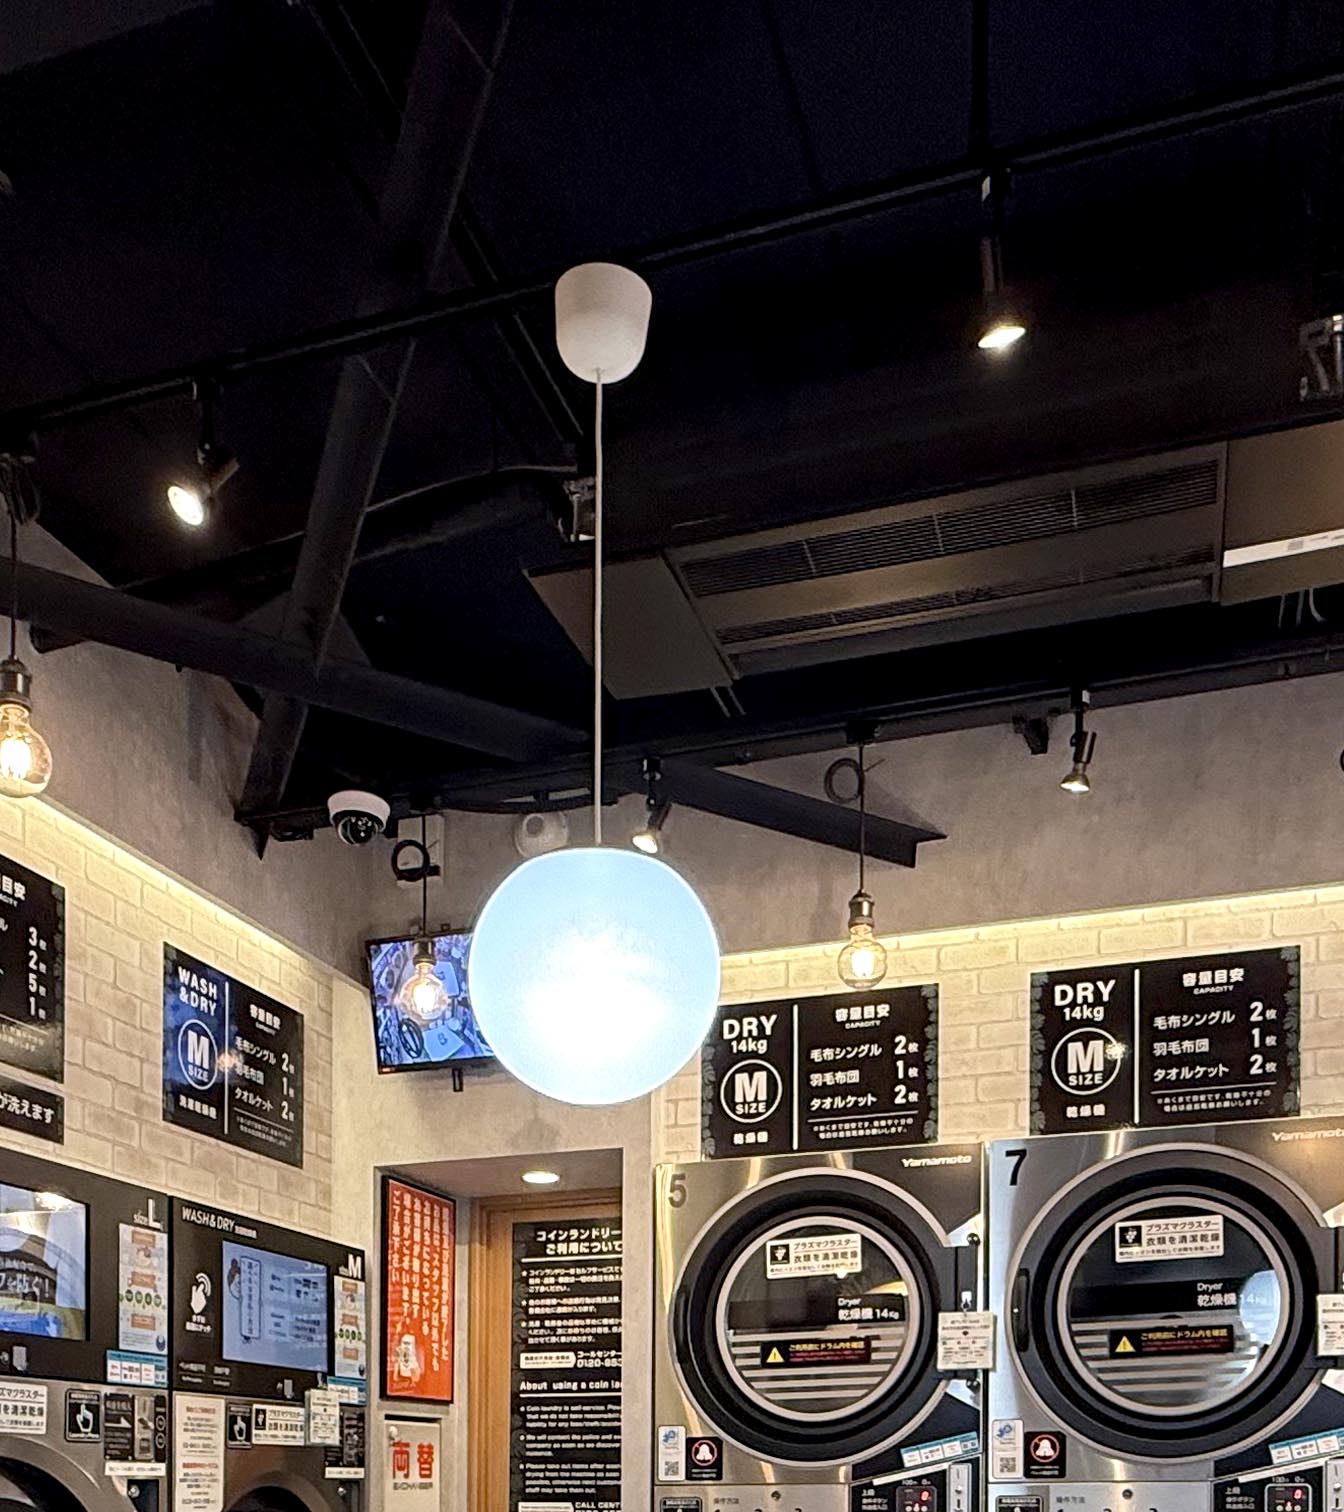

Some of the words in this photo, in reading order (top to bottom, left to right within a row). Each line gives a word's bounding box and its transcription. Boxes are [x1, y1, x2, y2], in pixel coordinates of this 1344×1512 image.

[177, 965, 219, 1001] WASH
[1182, 967, 1245, 988] 容量目安
[178, 986, 218, 1018] &DRY
[1053, 978, 1117, 1007] DRY
[1062, 1005, 1105, 1022] 14kg
[1152, 1009, 1236, 1031] 毛布シングル
[722, 1014, 777, 1040] DRY
[187, 1031, 211, 1071] M
[731, 1038, 768, 1055] 14kg
[809, 1043, 883, 1063] 毛布シングル
[1067, 1039, 1105, 1074] M
[1152, 1037, 1210, 1056] 羽毛布団
[187, 1065, 210, 1085] SIZE
[809, 1068, 860, 1087] 羽毛布団
[1068, 1072, 1104, 1086] SIZE
[1152, 1062, 1230, 1083] タオルケット
[734, 1071, 768, 1103] M
[735, 1101, 767, 1115] SIZE
[809, 1093, 878, 1112] タオルケット
[902, 1154, 972, 1168] Yamamoto
[1004, 1148, 1028, 1187] 7
[667, 1173, 688, 1209] 5
[1196, 1281, 1224, 1293] Dryer
